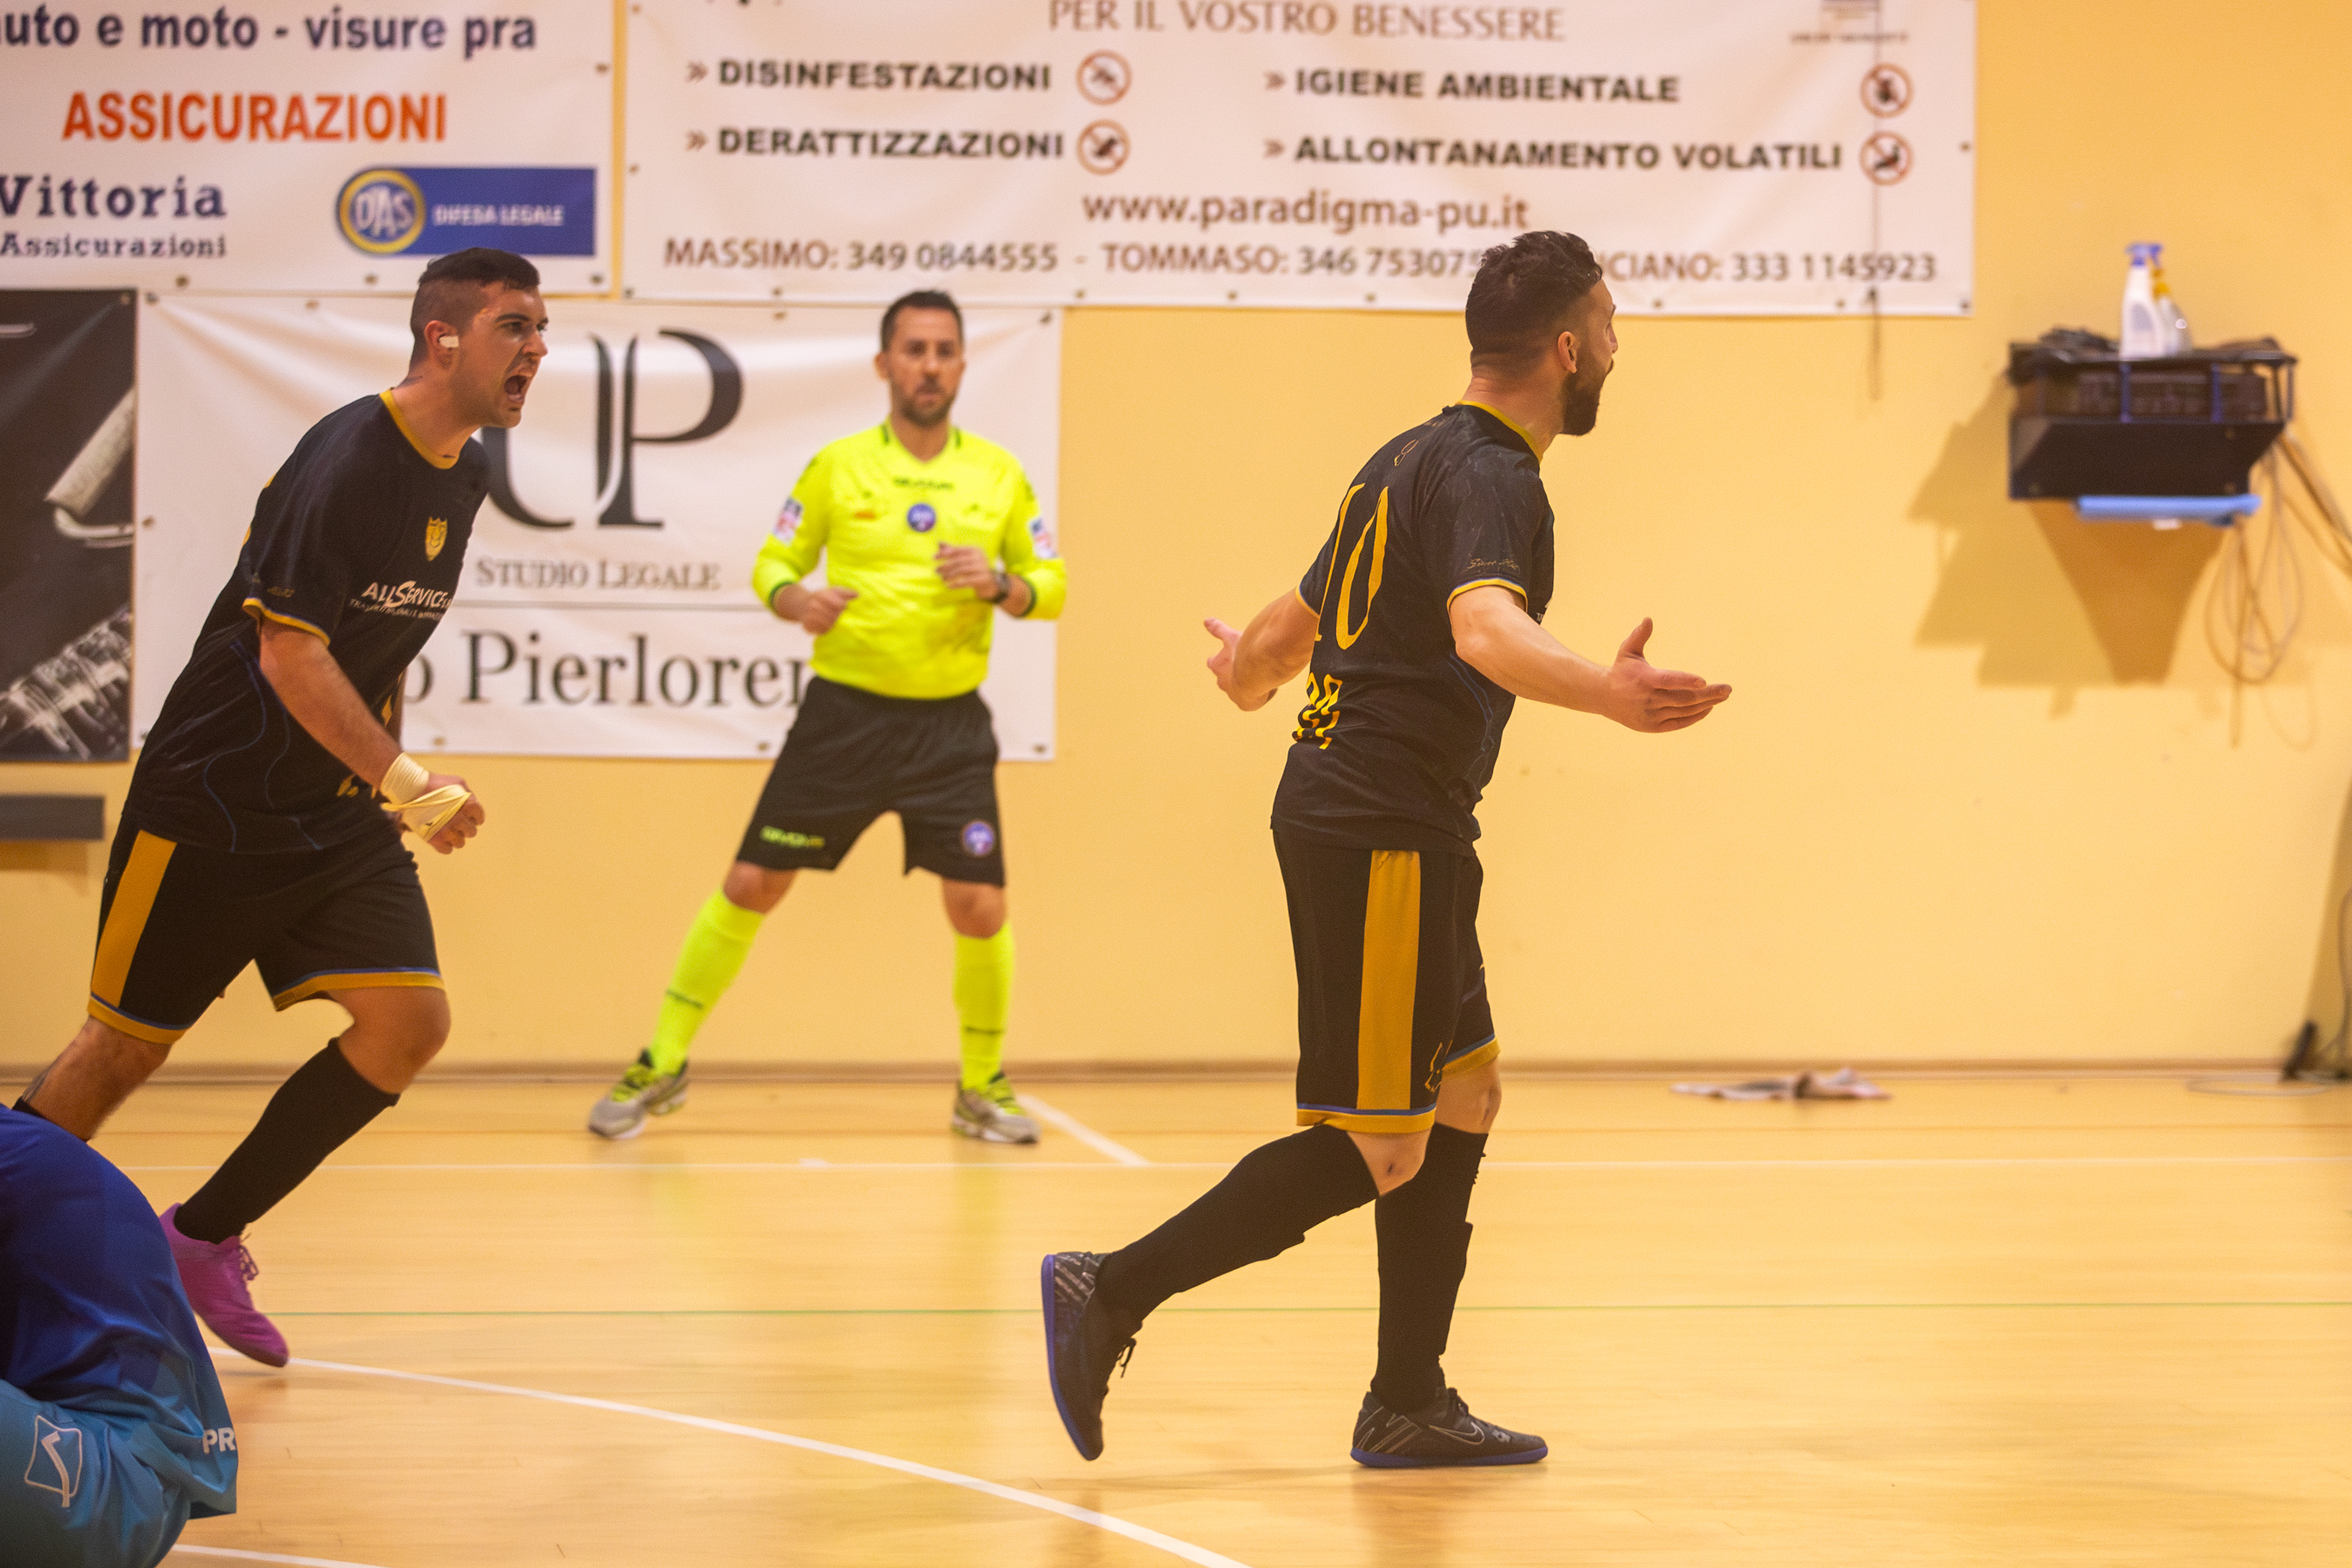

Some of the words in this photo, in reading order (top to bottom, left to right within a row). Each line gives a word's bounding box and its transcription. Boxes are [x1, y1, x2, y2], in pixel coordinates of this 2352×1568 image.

[0, 3, 80, 47] uto
[96, 14, 124, 48] e
[140, 6, 259, 50] moto
[303, 5, 447, 51] visure
[463, 17, 537, 61] pra
[1048, 0, 1120, 31] PER
[1134, 0, 1165, 31] IL
[1177, 0, 1338, 35] VOSTRO
[1350, 3, 1565, 41] BENESSERE
[719, 58, 1051, 91] DISINFESTAZIONI
[1295, 69, 1423, 98] IGIENE
[1436, 72, 1679, 103] AMBIENTALE
[62, 91, 447, 142] ASSICURAZIONI
[718, 127, 1064, 159] DERATTIZZAZIONI
[1294, 136, 1661, 170] ALLONTANAMENTO
[1677, 144, 1842, 171] VOLATILI
[0, 174, 226, 220] Vittoria
[1082, 188, 1529, 236] www.paradigma-pu.it
[0, 231, 226, 259] Assicurazioni
[664, 237, 838, 271] MASSIMO:
[848, 241, 909, 271] 349
[915, 242, 1059, 272] 0844555
[1102, 242, 1288, 274] TOMMASO:
[1299, 246, 1358, 276] 346
[1733, 253, 1790, 281] 333
[1802, 253, 1937, 282] 1145923
[476, 556, 590, 590] STUDIO
[598, 557, 722, 592] LEGALE
